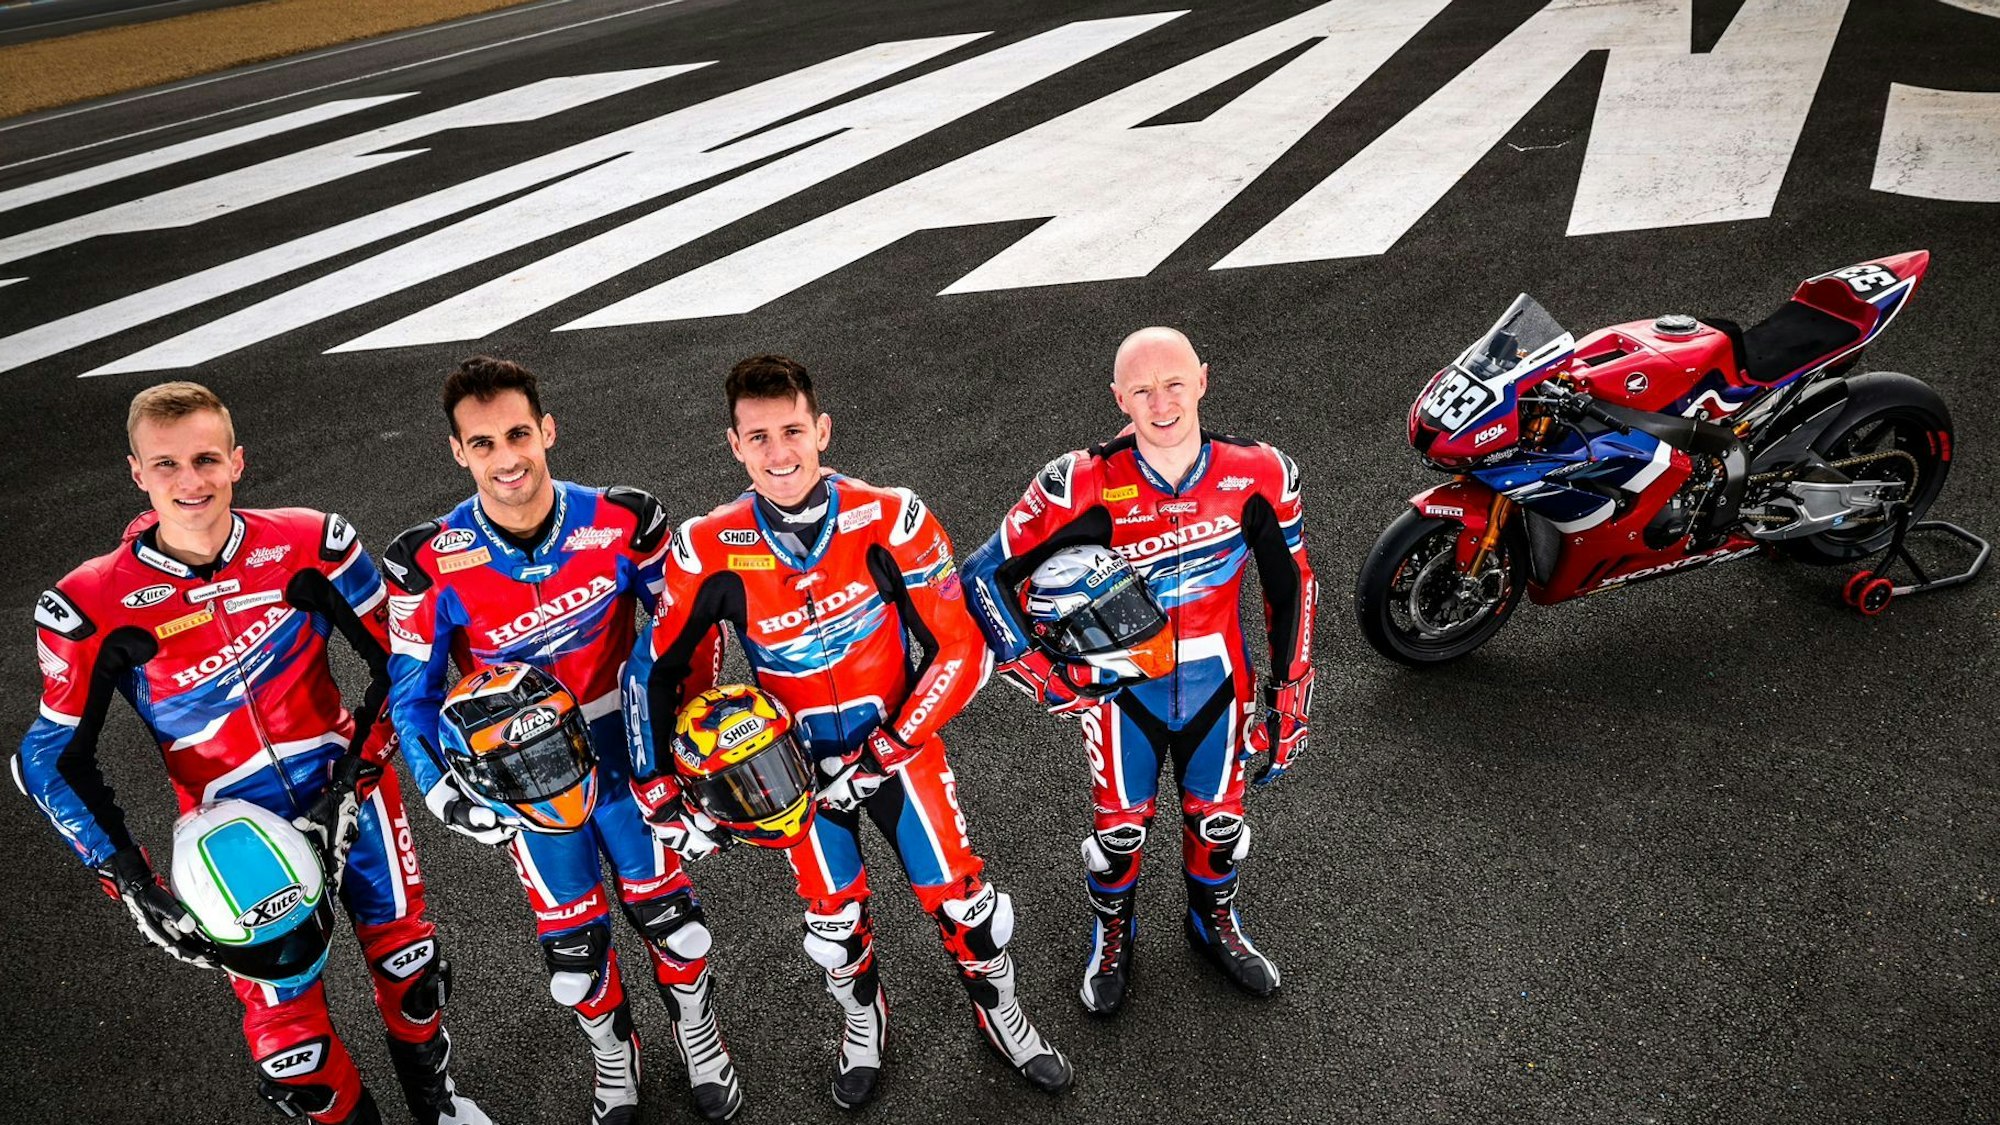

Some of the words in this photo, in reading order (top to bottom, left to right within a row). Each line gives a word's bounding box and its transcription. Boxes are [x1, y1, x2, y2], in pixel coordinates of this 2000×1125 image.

[1475, 424, 1507, 444] IGOL
[1115, 513, 1155, 525] SHARK
[1425, 505, 1463, 517] PIRELLI
[435, 530, 473, 549] Airoh
[562, 533, 615, 550] Racing
[723, 531, 756, 543] SHOEI
[762, 529, 792, 565] HONDA
[813, 517, 836, 558] HONDA
[1111, 513, 1240, 561] HONDA
[440, 552, 490, 571] PIRELLI
[733, 557, 771, 567] PIRELLI
[1088, 559, 1125, 586] SHARK
[1598, 549, 1730, 587] HONDA
[133, 587, 167, 606] X-lite
[484, 575, 616, 646] HONDA
[757, 580, 869, 636] HONDA
[389, 612, 425, 644] NDA
[1299, 579, 1314, 664] HONDA
[171, 606, 288, 687] HONDA
[899, 658, 963, 742] HONDA
[509, 708, 556, 740] Airoh
[723, 718, 760, 745] SHOEI
[1081, 701, 1108, 789] IGOL
[392, 802, 421, 886] IGOL
[251, 890, 298, 926] X-lite
[810, 919, 855, 932] 4SR
[271, 1049, 314, 1073] SLR
